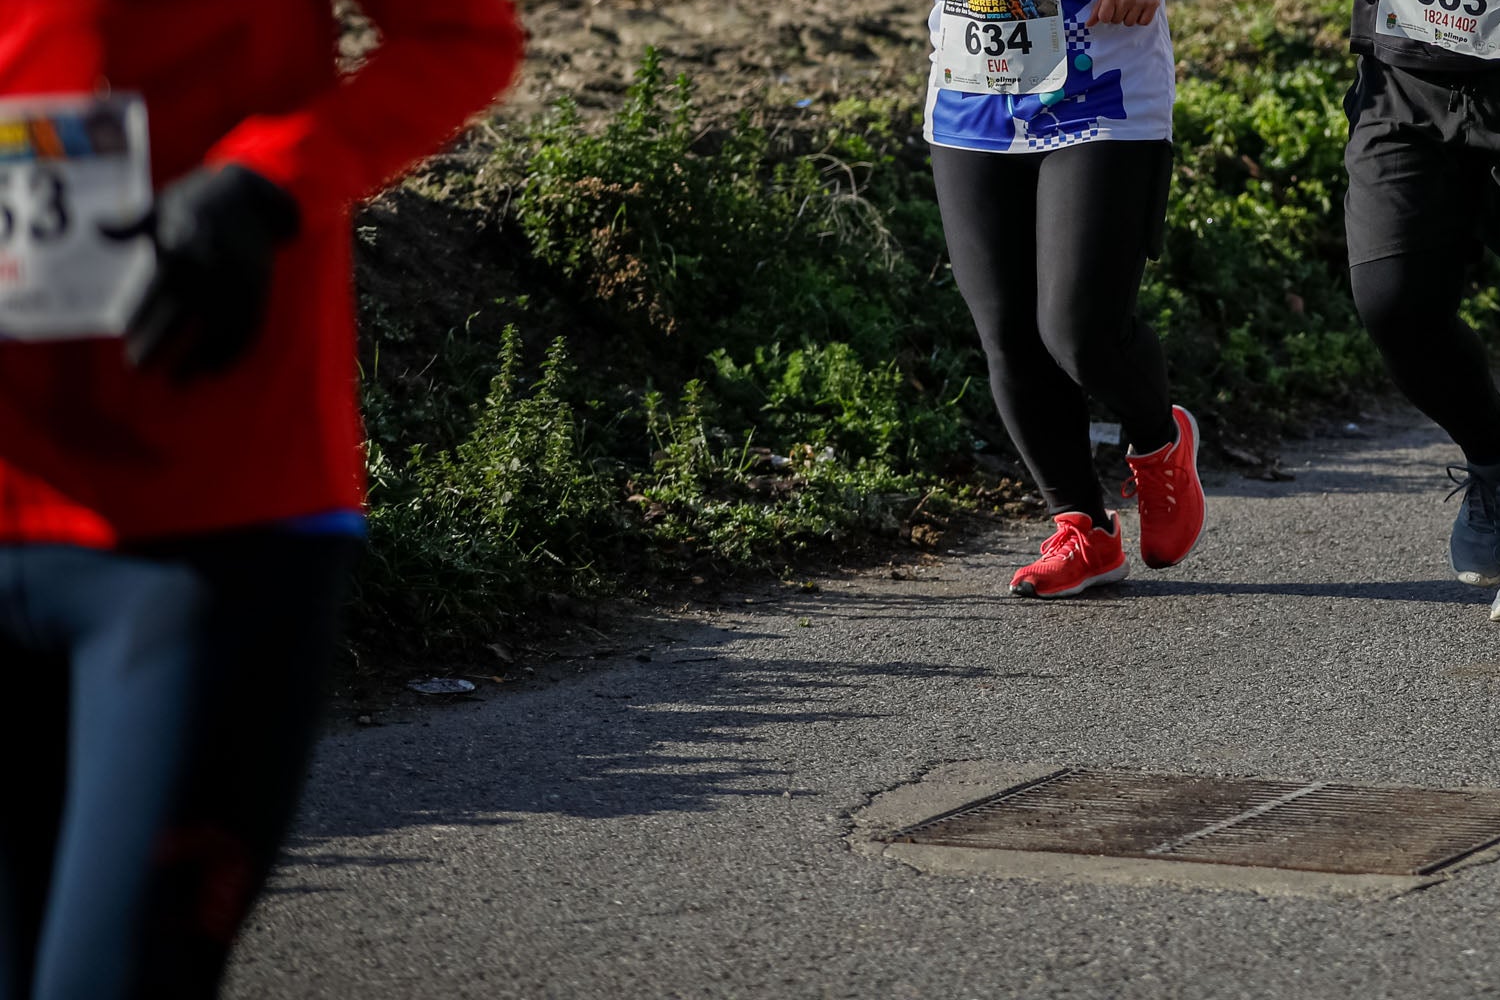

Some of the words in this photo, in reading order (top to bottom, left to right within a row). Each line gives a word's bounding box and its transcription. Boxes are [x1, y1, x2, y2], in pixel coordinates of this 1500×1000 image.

[1423, 9, 1477, 33] 18241402
[965, 21, 1032, 56] 634
[1443, 32, 1468, 43] olimpo
[987, 59, 1009, 72] EVA
